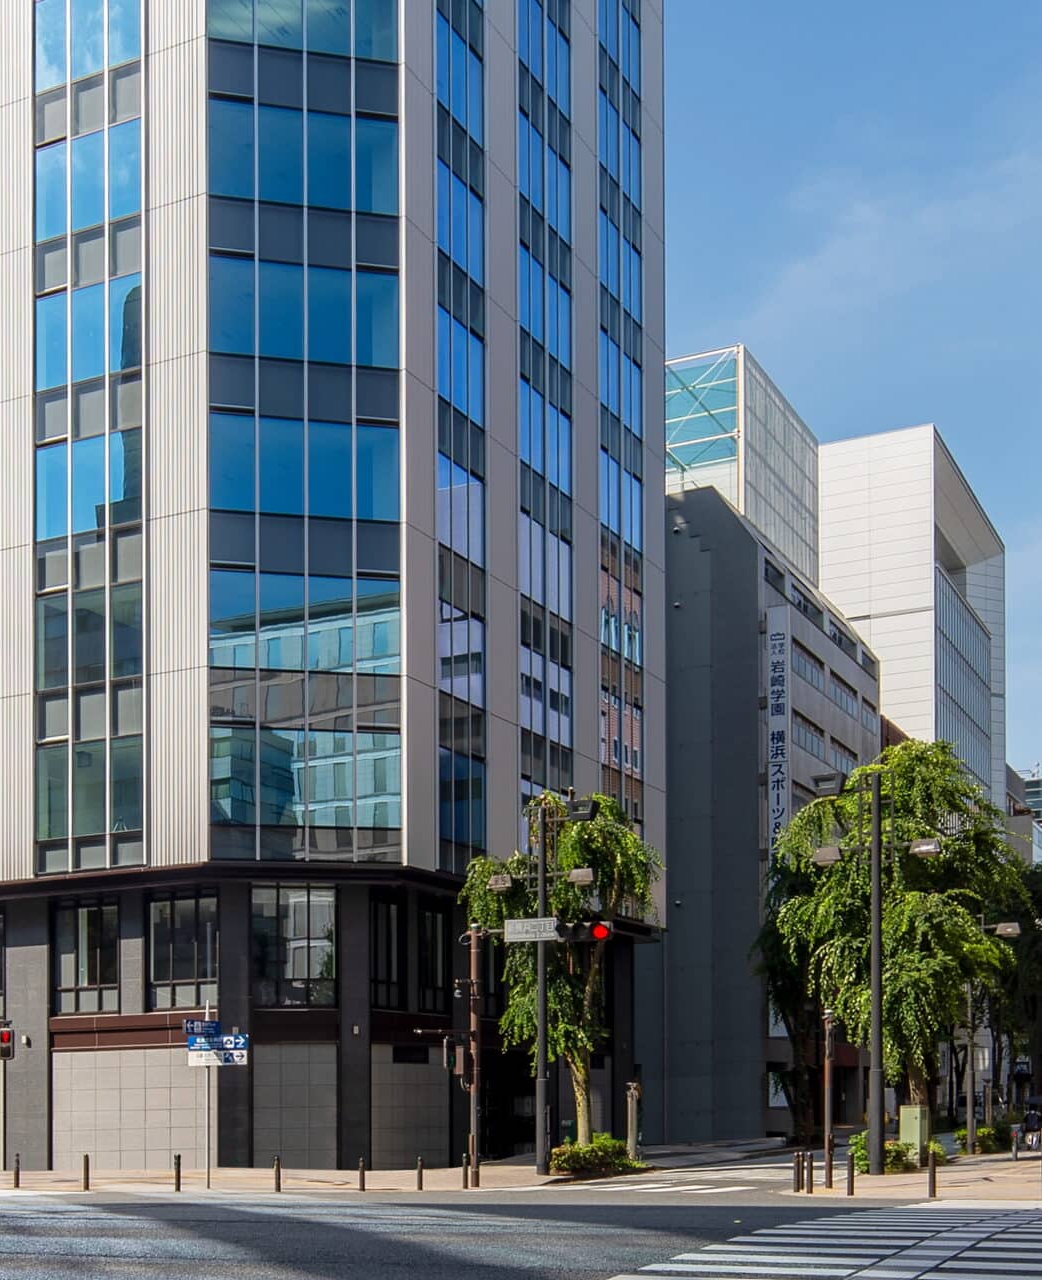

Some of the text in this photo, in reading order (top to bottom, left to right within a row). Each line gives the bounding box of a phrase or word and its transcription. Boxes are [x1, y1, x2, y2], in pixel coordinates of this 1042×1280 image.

[770, 730, 787, 867] 横浜スポーツ&
